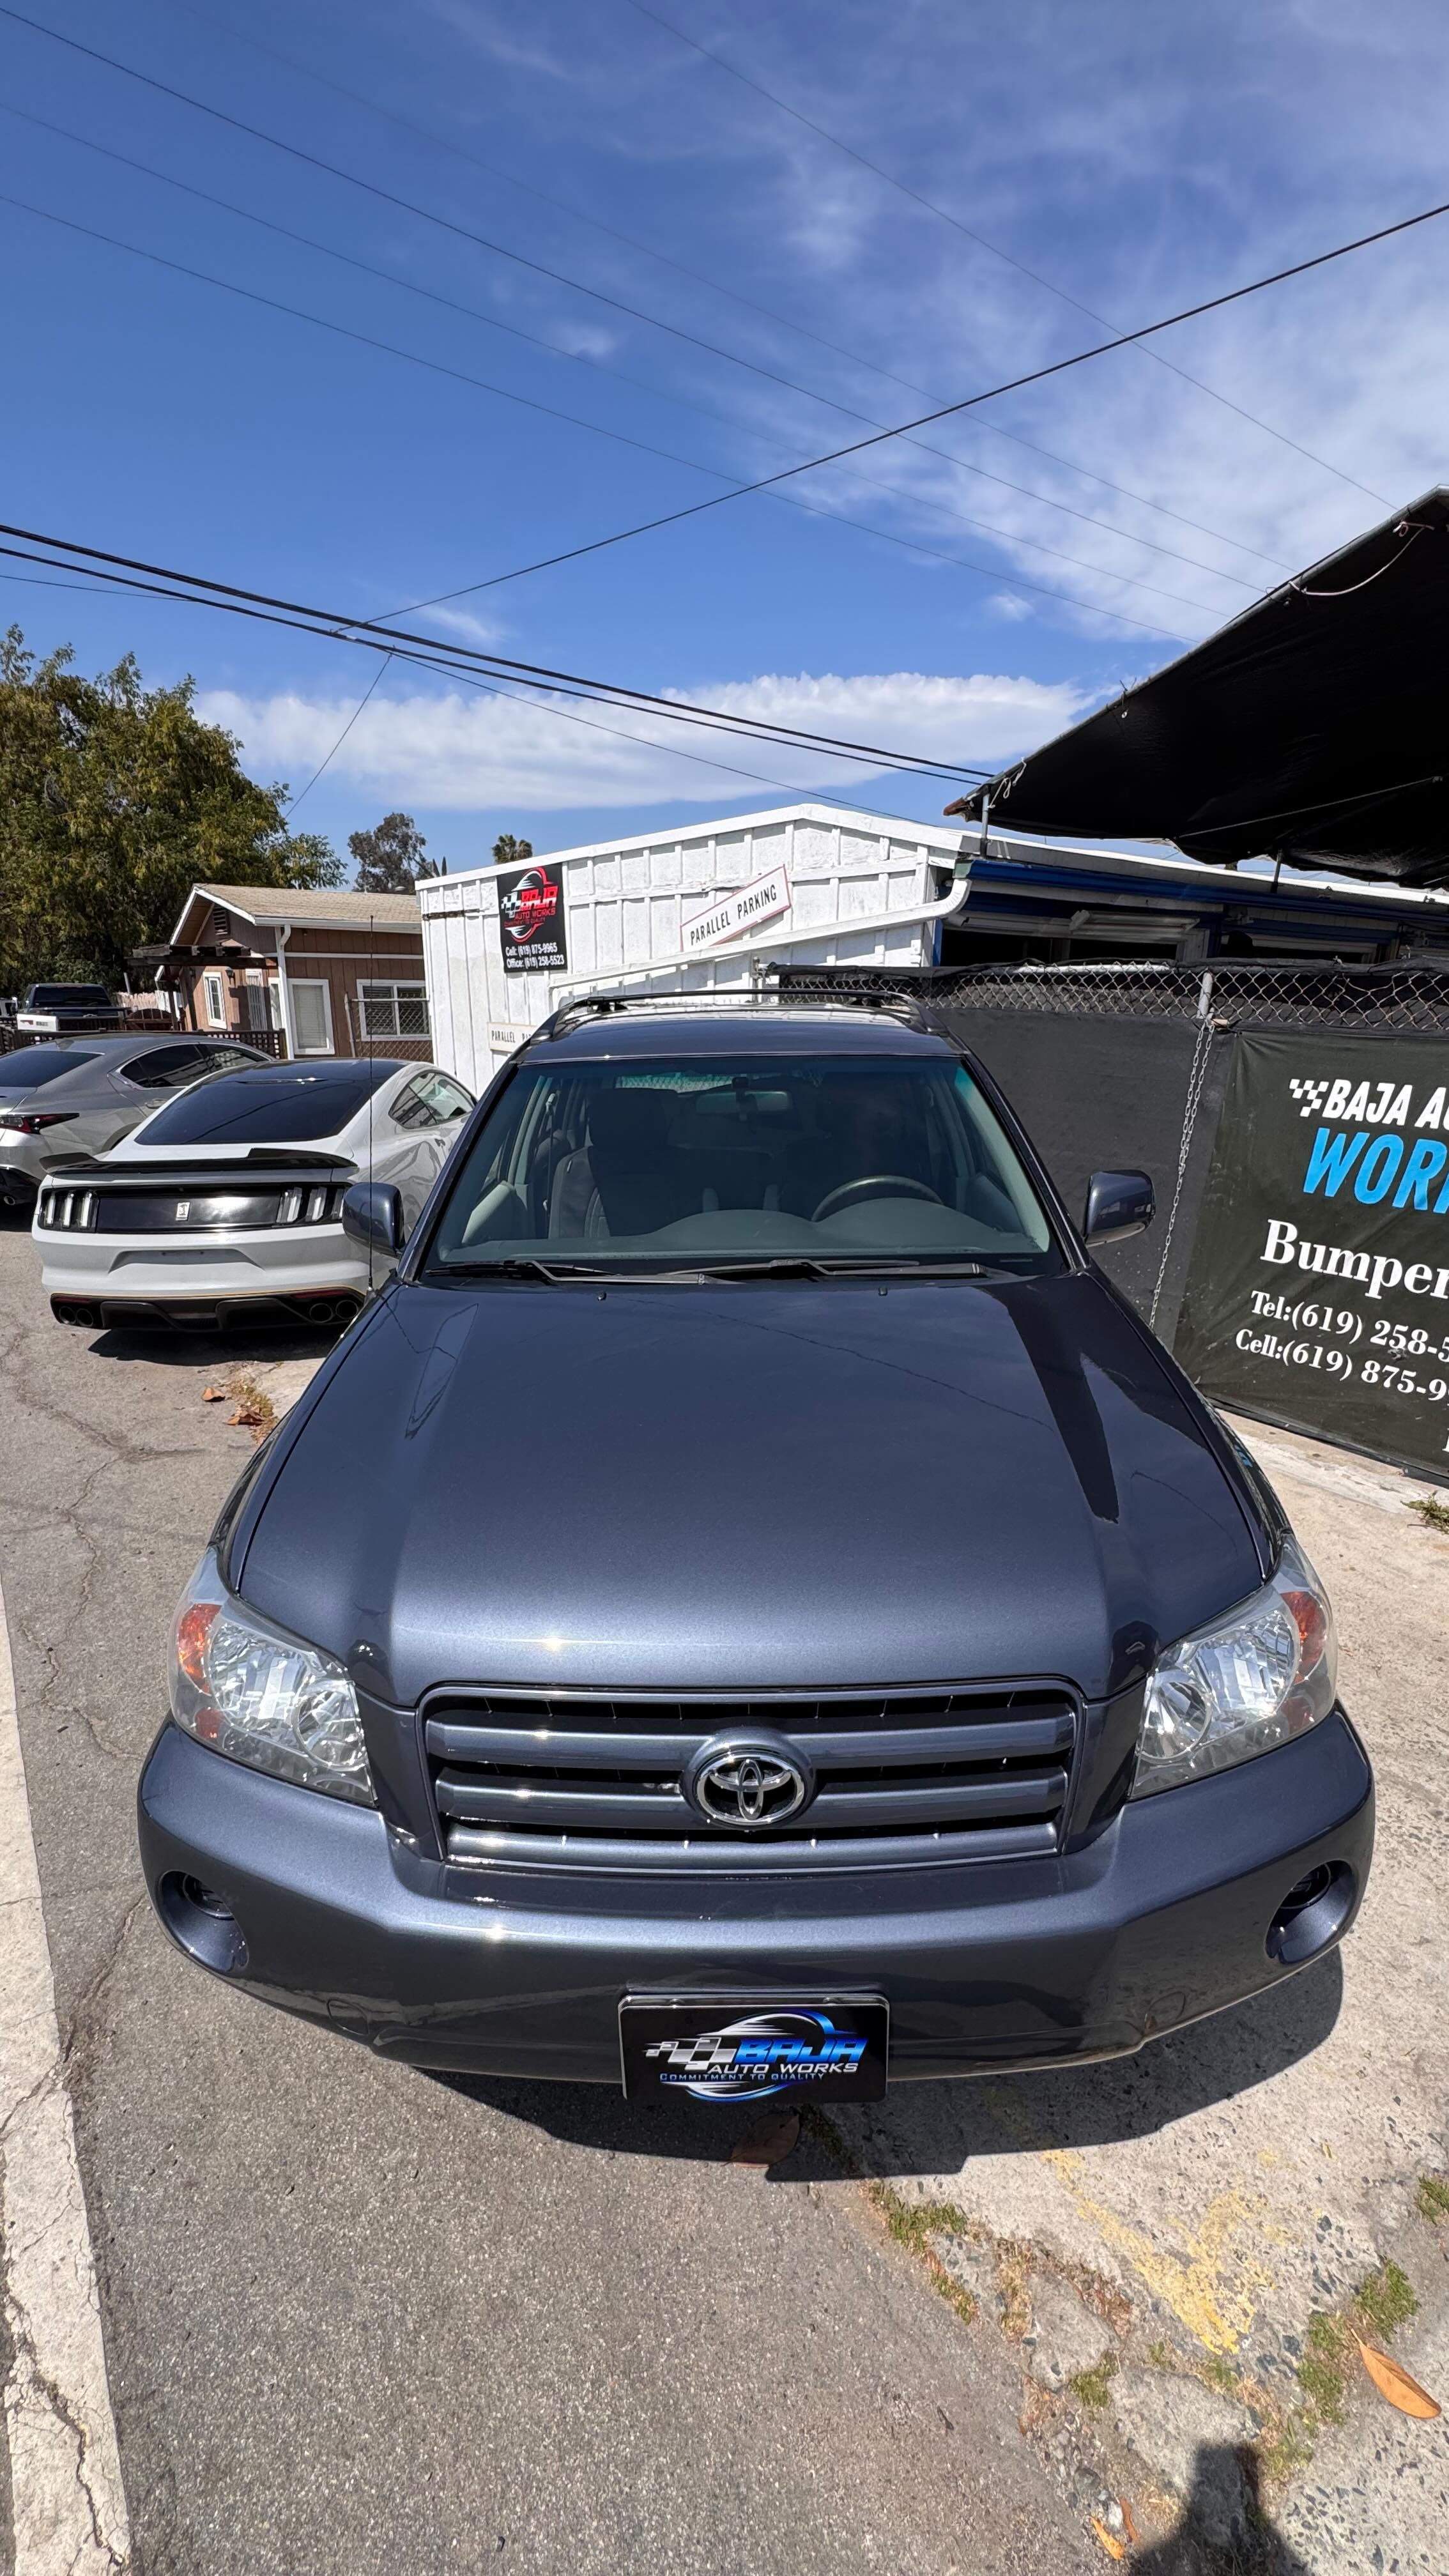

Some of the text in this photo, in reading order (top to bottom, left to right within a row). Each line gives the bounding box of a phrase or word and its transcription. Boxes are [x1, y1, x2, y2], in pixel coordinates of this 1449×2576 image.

[690, 884, 777, 946] PARALLEL PARKING
[518, 945, 532, 958] (619)
[525, 956, 538, 969] (619)
[491, 1030, 516, 1043] PARALLEL
[1322, 1078, 1413, 1126] BAJA
[1303, 1127, 1449, 1213] WOR
[1361, 1360, 1449, 1401] 875-9
[735, 2037, 869, 2063] BAJA
[707, 2063, 859, 2074] AUTO WORKS
[771, 2073, 825, 2081] QUALITY
